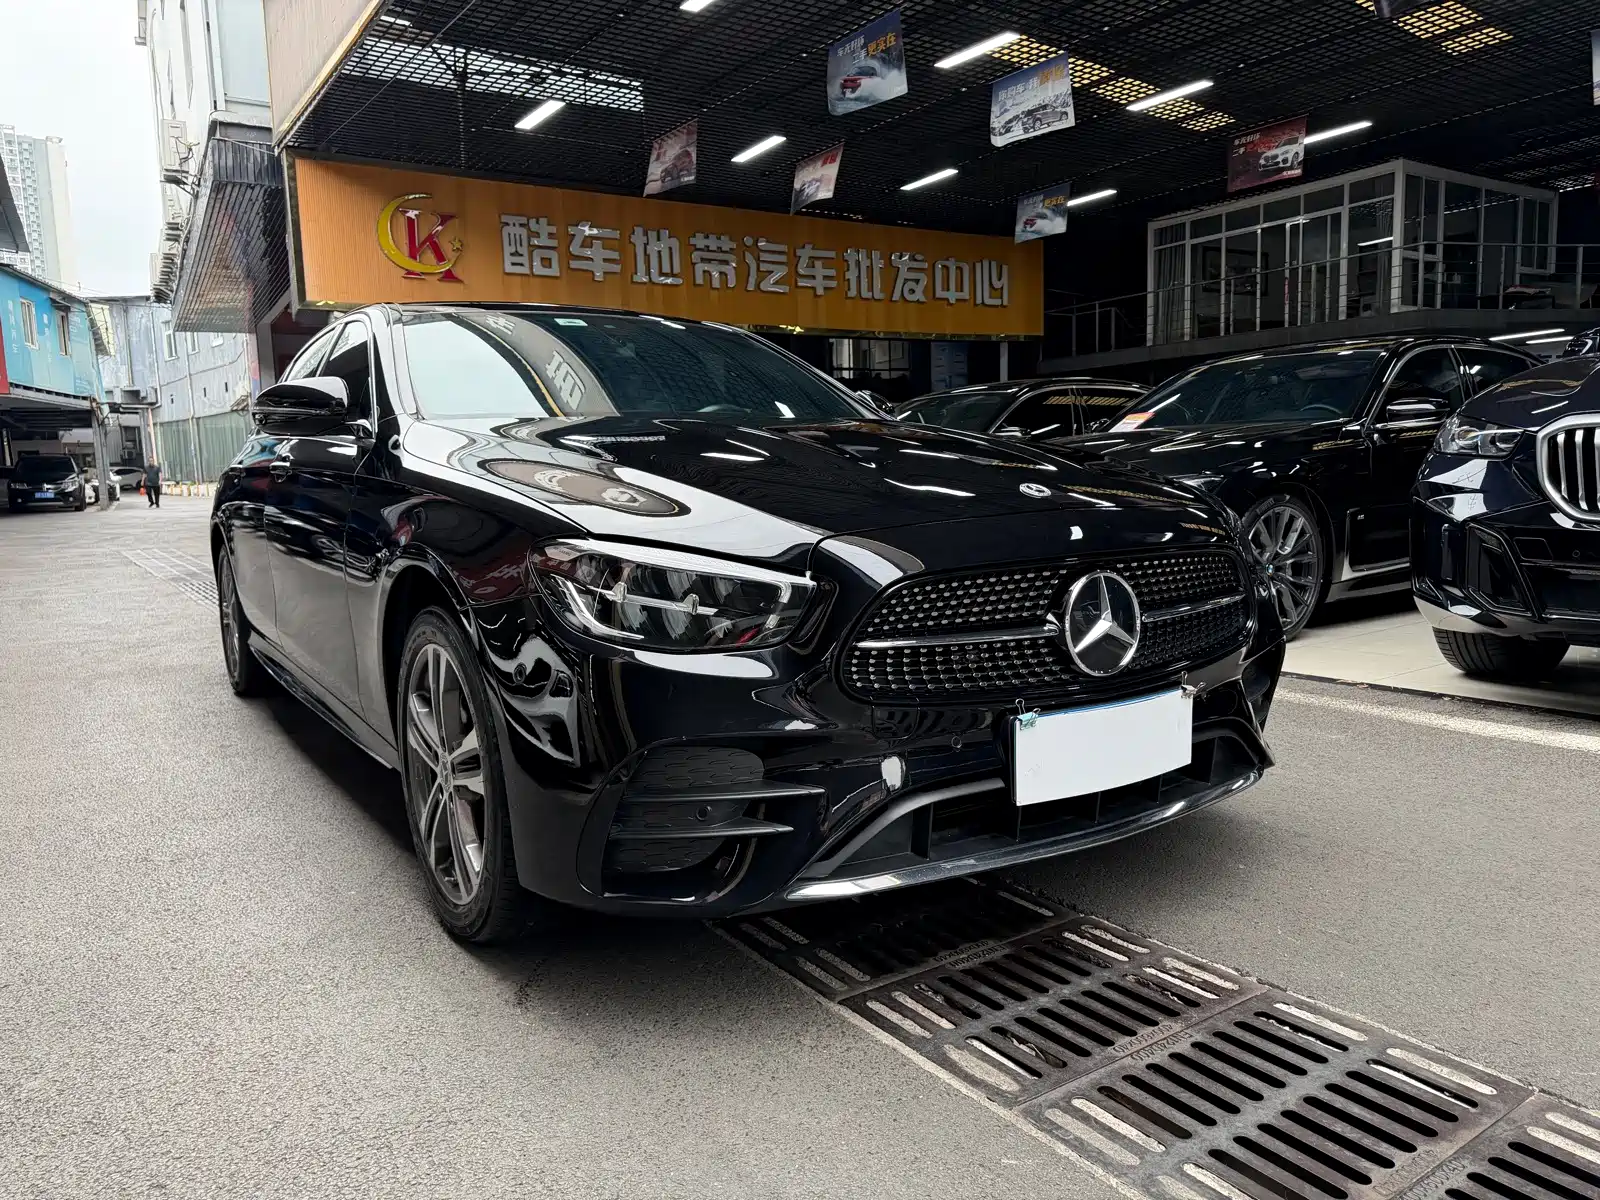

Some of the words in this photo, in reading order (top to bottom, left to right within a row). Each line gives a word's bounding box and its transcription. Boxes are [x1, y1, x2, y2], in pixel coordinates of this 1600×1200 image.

[500, 212, 1010, 307] 酷车地带汽车批发中心
